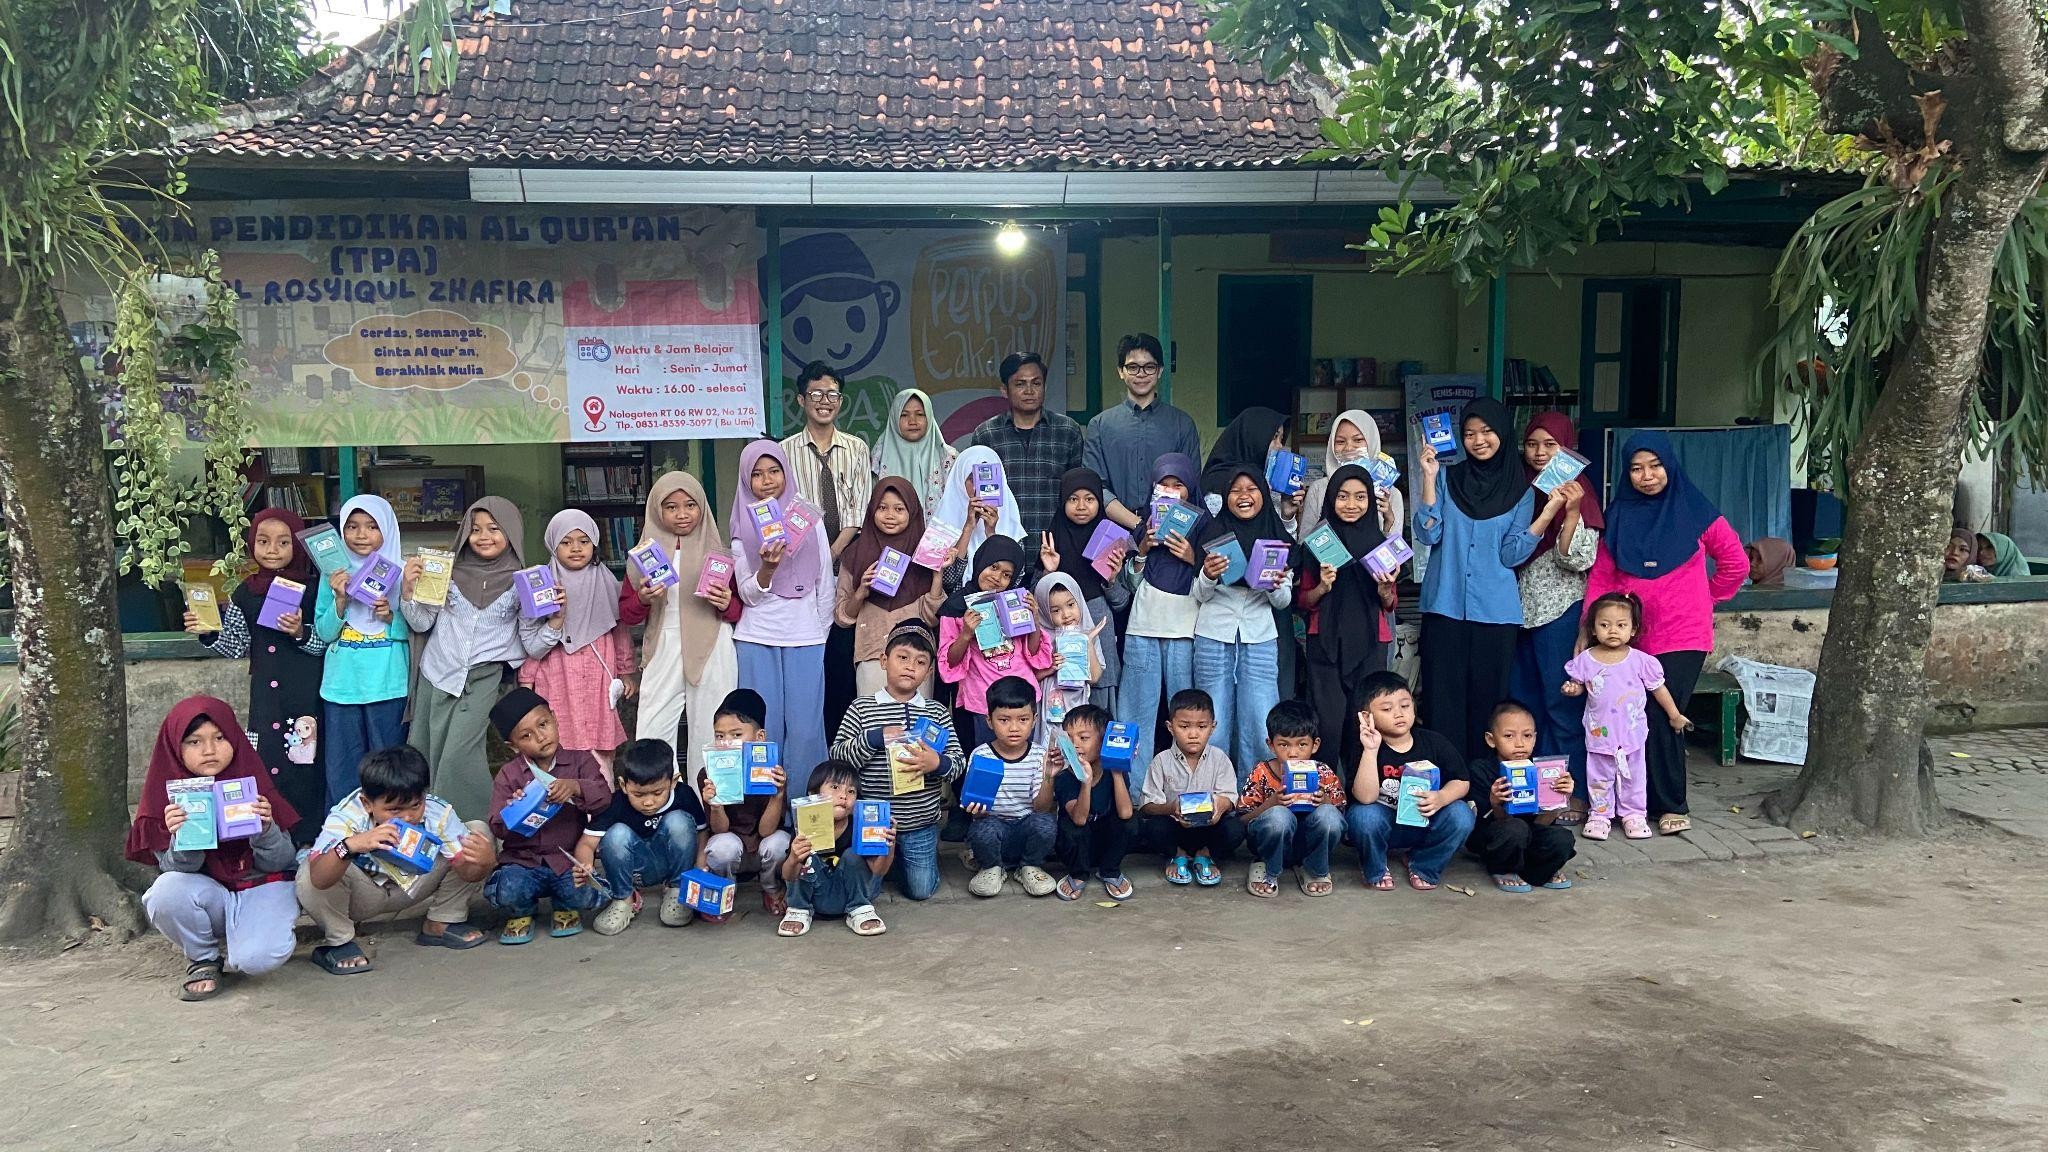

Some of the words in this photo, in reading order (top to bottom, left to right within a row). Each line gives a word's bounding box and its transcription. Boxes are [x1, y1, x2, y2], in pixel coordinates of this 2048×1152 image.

[209, 214, 467, 241] PENDIDIKAN
[480, 215, 529, 241] AL
[540, 215, 680, 244] QUR'AN
[331, 246, 438, 276] (TPA)
[222, 278, 252, 299] L
[264, 277, 416, 305] ROSYIQUL
[428, 277, 554, 305] ZHAFIRA
[360, 327, 412, 339] Cerdas,
[415, 327, 487, 342] Semangat,
[374, 345, 411, 357] Cinta
[414, 345, 428, 357] Al
[431, 345, 479, 358] Qur'an,
[614, 345, 650, 355] Waktu
[653, 344, 662, 354] &
[665, 345, 691, 354] Jam
[694, 344, 734, 356] Belajar
[375, 364, 445, 376] Berakhlak
[448, 364, 484, 376] Mulia
[615, 365, 640, 374] Hari
[670, 364, 701, 373] Senin
[711, 363, 748, 373] Jumat
[616, 385, 653, 395] Waktu
[664, 384, 695, 394] 16.00
[706, 383, 747, 393] selesai
[609, 410, 658, 421] Nologaten
[660, 409, 672, 417] RT
[674, 409, 686, 417] 06
[688, 408, 703, 417] RW
[722, 408, 735, 416] No
[616, 421, 633, 430] Tlp.
[635, 419, 712, 429] 0831-8339-3097
